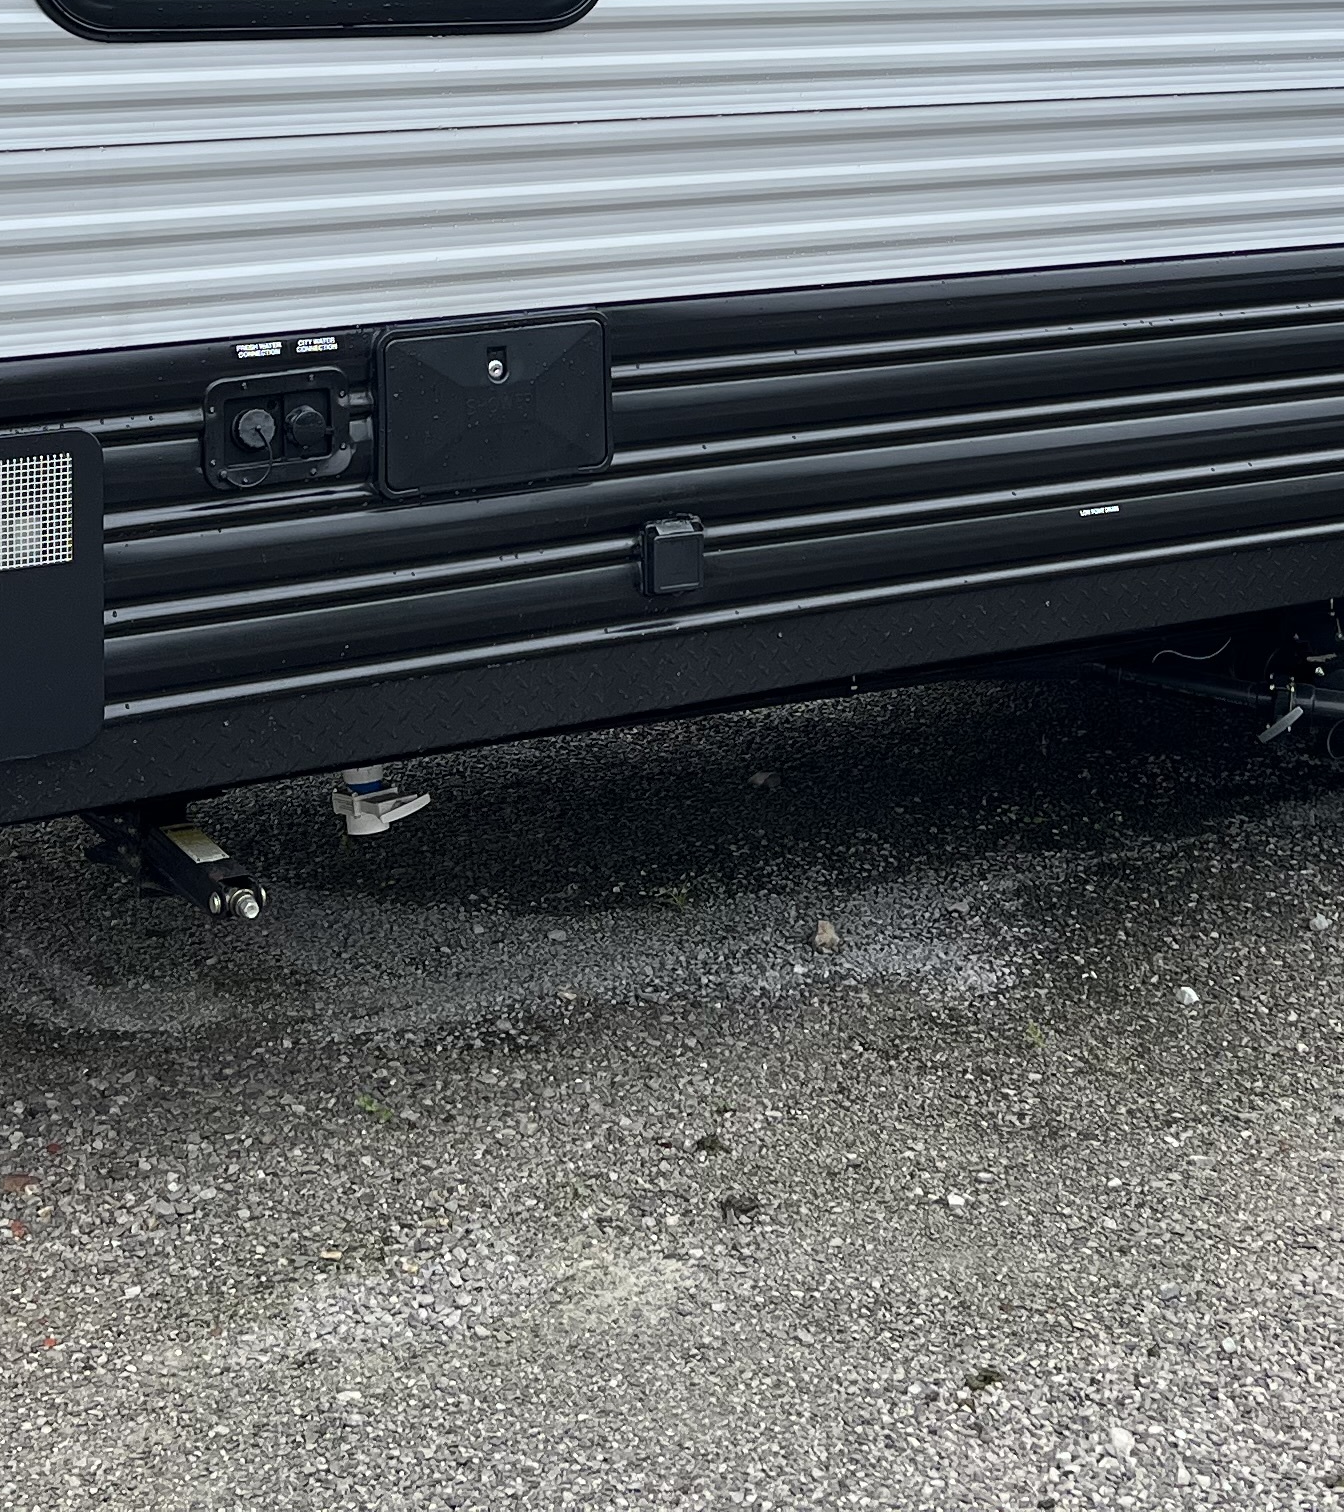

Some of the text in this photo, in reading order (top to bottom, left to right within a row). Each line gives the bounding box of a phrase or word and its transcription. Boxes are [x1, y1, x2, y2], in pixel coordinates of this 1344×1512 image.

[259, 341, 282, 350] WATER
[296, 343, 338, 353] CONNECTION
[237, 349, 281, 359] CONNECTION
